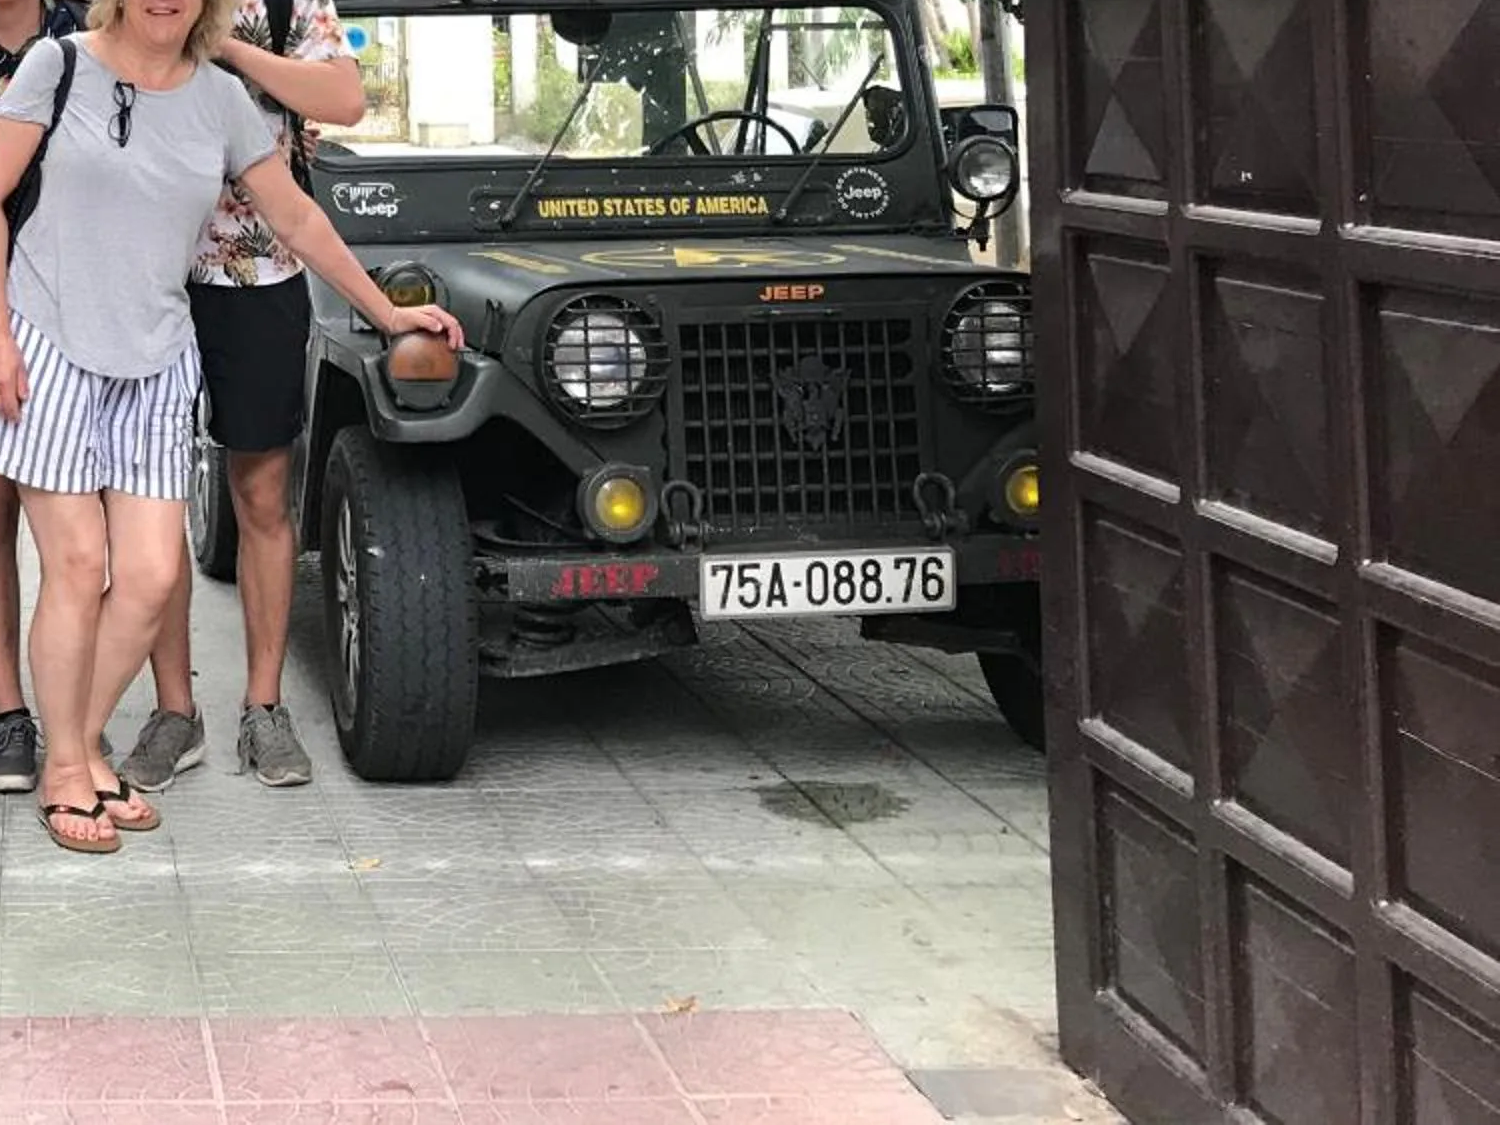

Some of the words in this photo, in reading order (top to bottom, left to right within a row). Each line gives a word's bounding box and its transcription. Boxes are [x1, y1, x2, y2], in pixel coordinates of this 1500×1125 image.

[843, 185, 882, 200] Jeep
[353, 199, 399, 218] Jeep
[537, 198, 599, 218] UNITED
[602, 197, 667, 217] STATES
[669, 197, 691, 215] OF
[695, 195, 769, 215] AMERICA
[759, 283, 825, 302] JEEP
[710, 555, 946, 610] 75A-088.76
